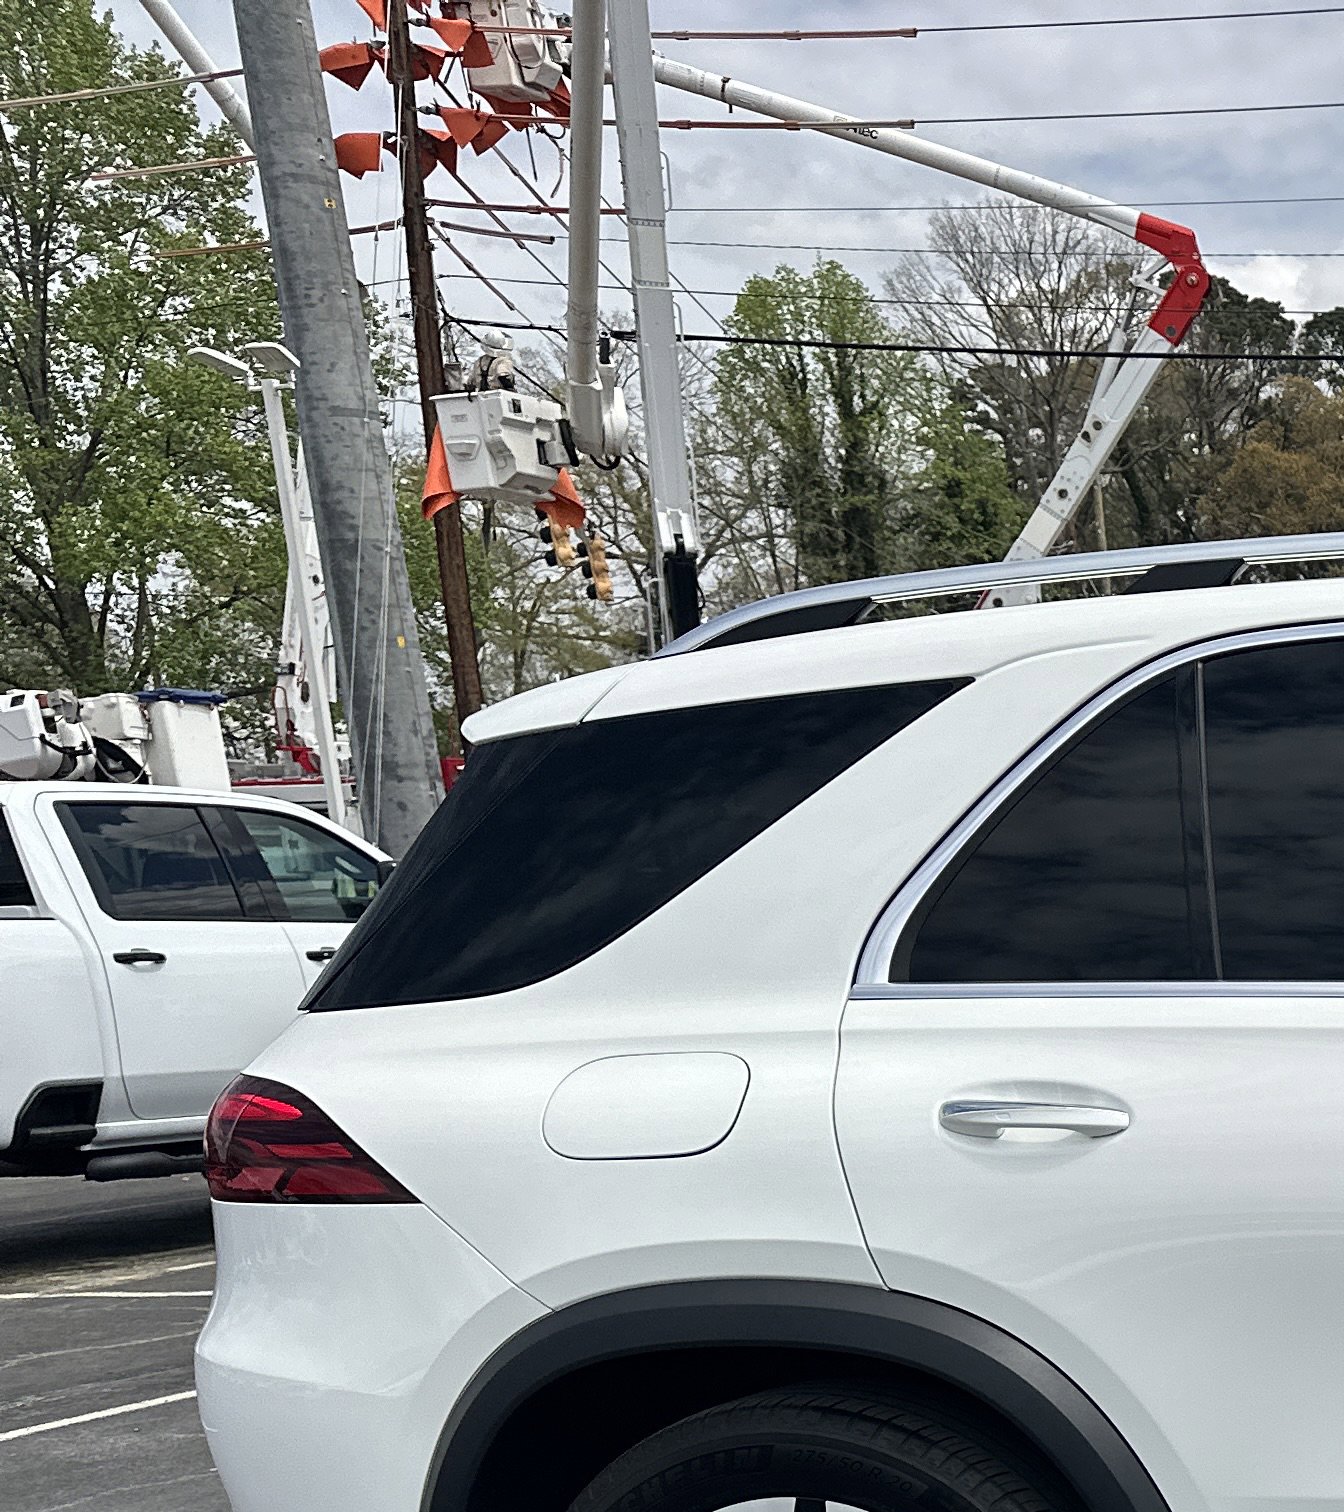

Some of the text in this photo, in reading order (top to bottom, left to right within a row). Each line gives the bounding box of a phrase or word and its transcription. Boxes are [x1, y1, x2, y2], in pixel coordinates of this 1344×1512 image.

[793, 1448, 913, 1493] 275/50 R 20
